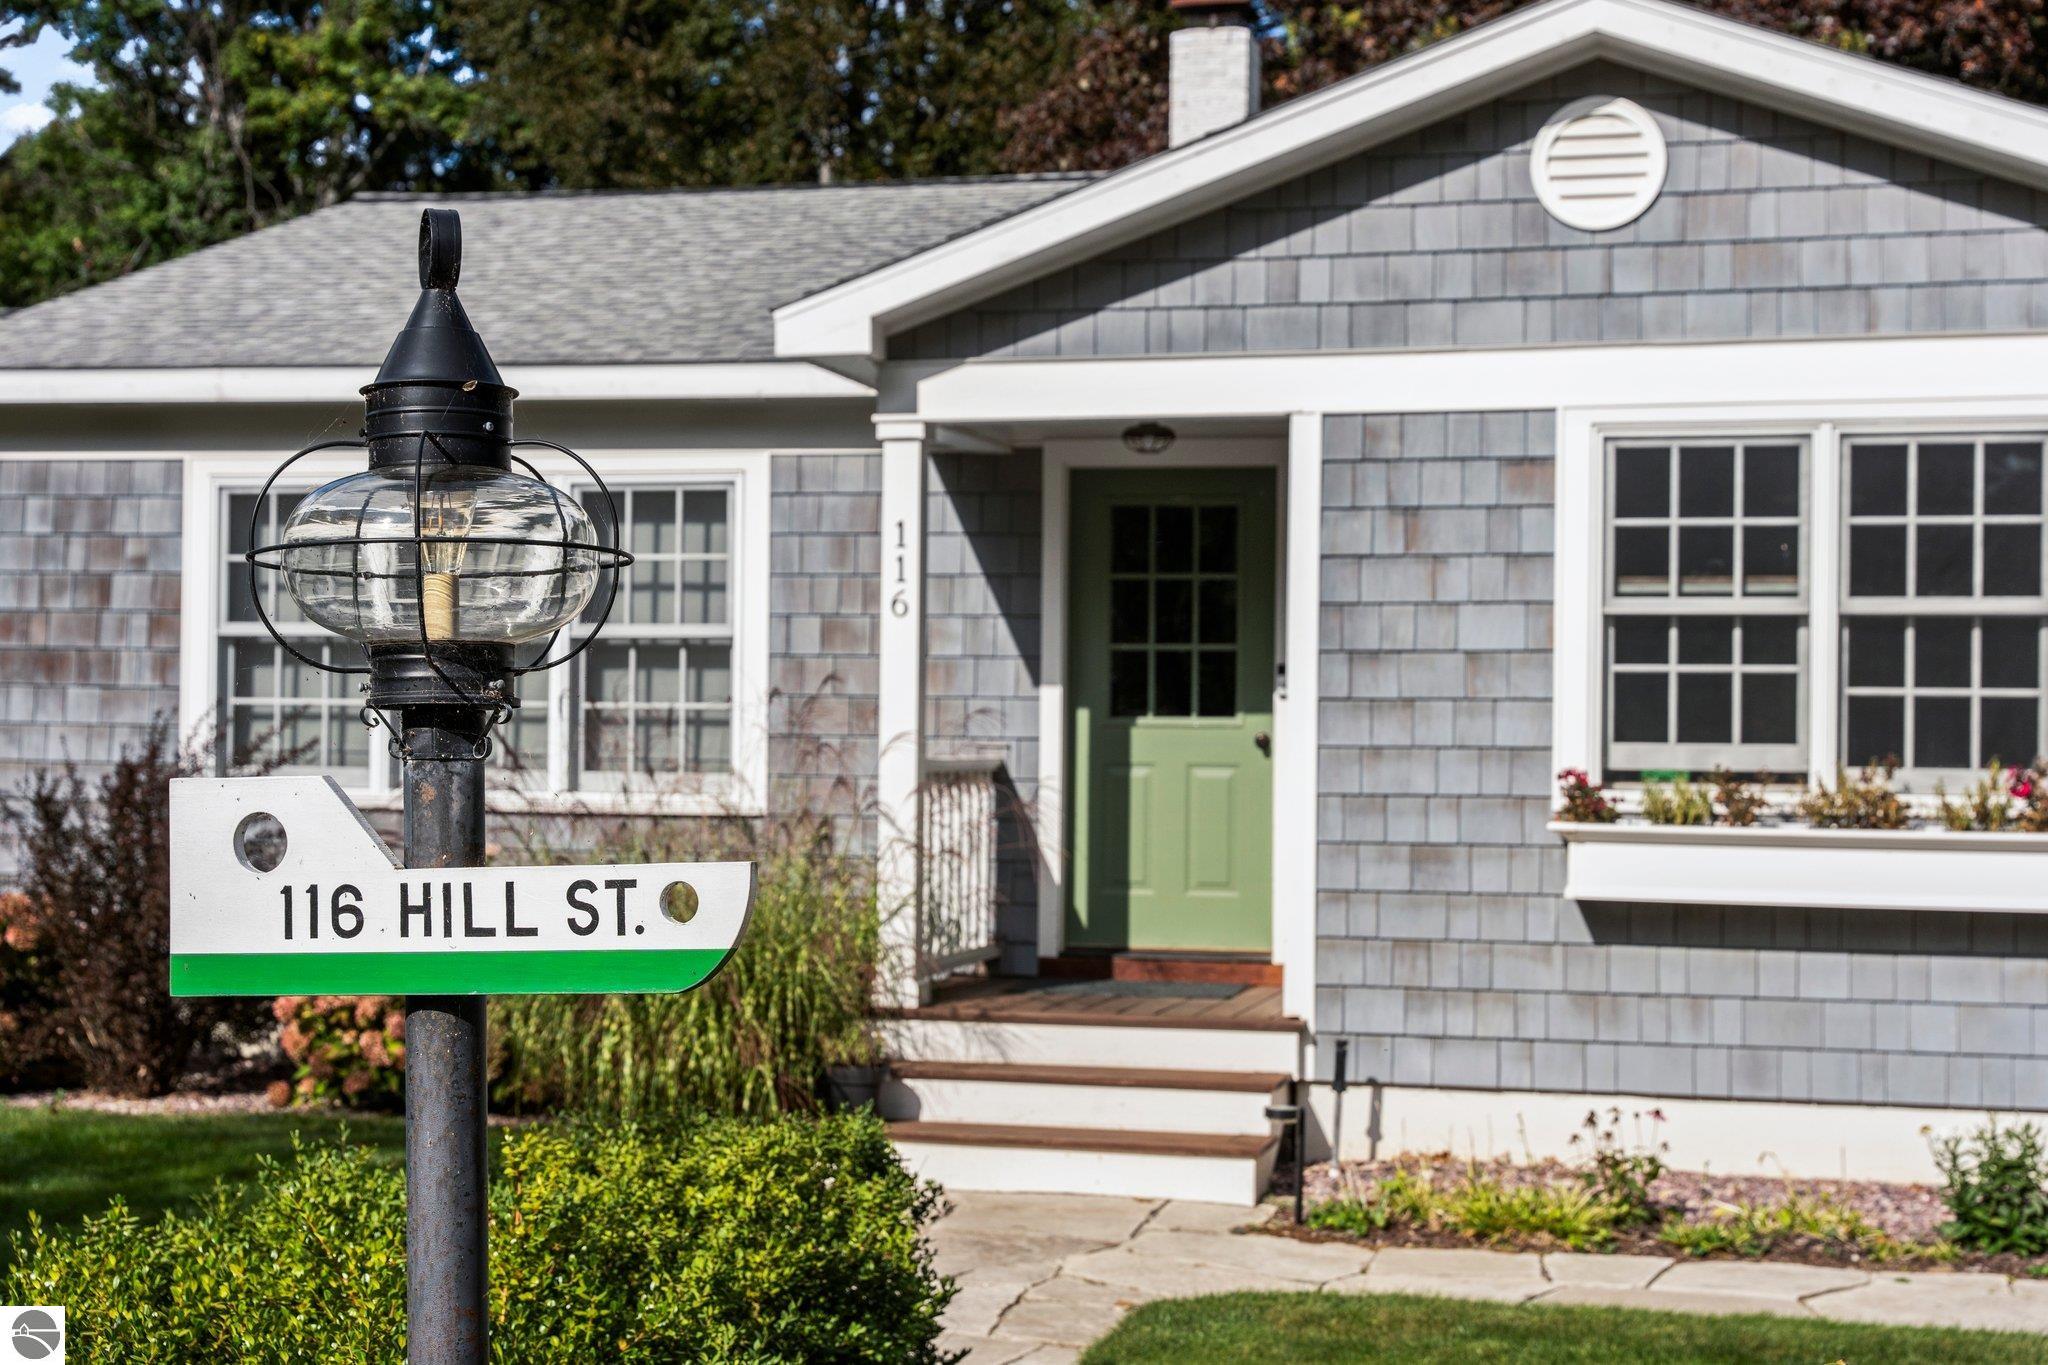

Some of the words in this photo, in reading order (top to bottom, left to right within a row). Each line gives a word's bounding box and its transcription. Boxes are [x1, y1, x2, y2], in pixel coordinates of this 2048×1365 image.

[891, 519, 908, 618] 116
[279, 883, 364, 940] 116
[399, 881, 539, 938] HILL
[566, 878, 645, 937] ST.
